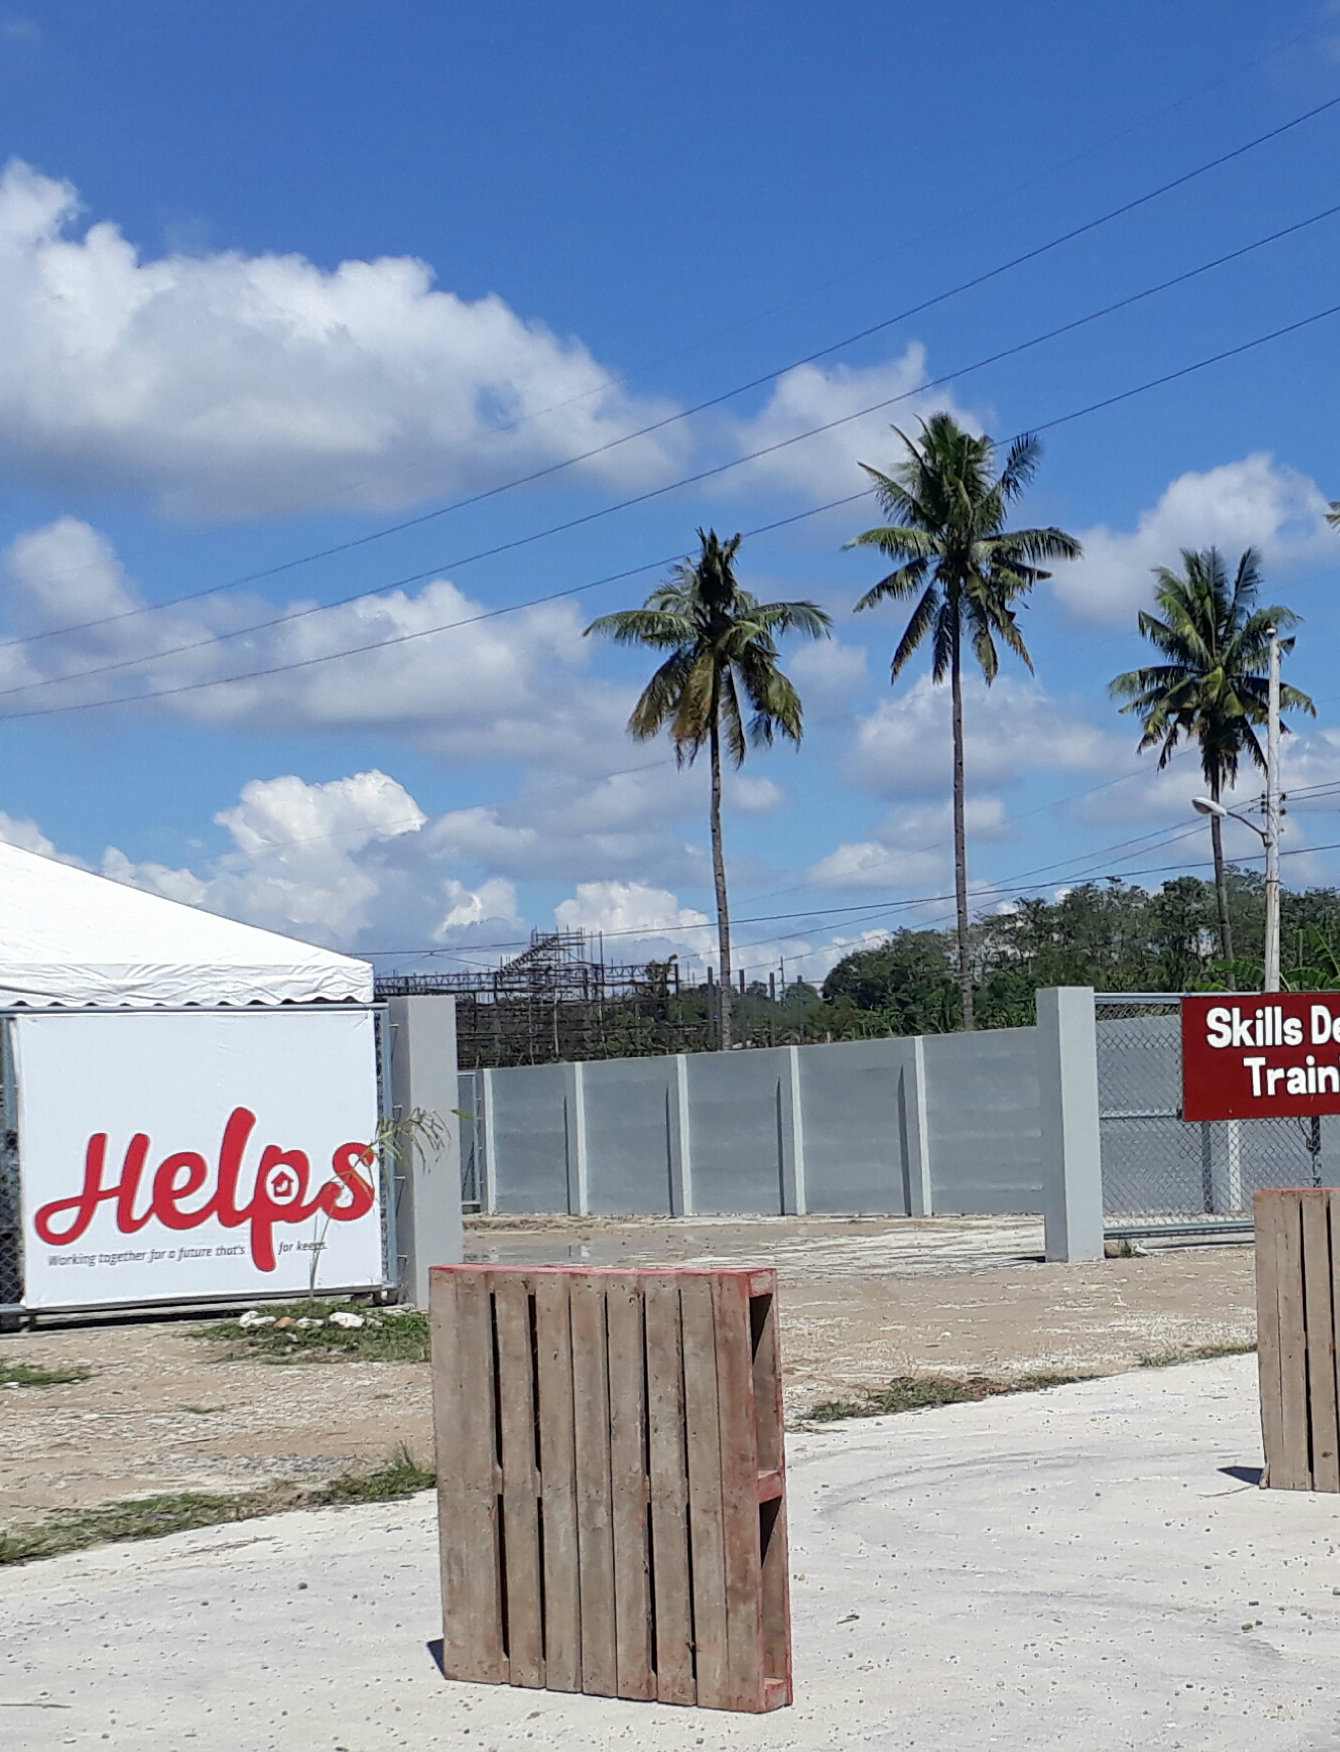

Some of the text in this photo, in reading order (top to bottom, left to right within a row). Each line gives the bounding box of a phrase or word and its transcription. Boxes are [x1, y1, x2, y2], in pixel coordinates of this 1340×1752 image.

[1206, 1006, 1304, 1048] Skills
[34, 1106, 375, 1272] Helps
[48, 1254, 95, 1267] Working
[98, 1250, 146, 1266] together
[146, 1249, 167, 1264] for
[168, 1250, 176, 1259] a
[177, 1246, 213, 1262] future
[215, 1244, 246, 1257] that's
[277, 1240, 294, 1256] for
